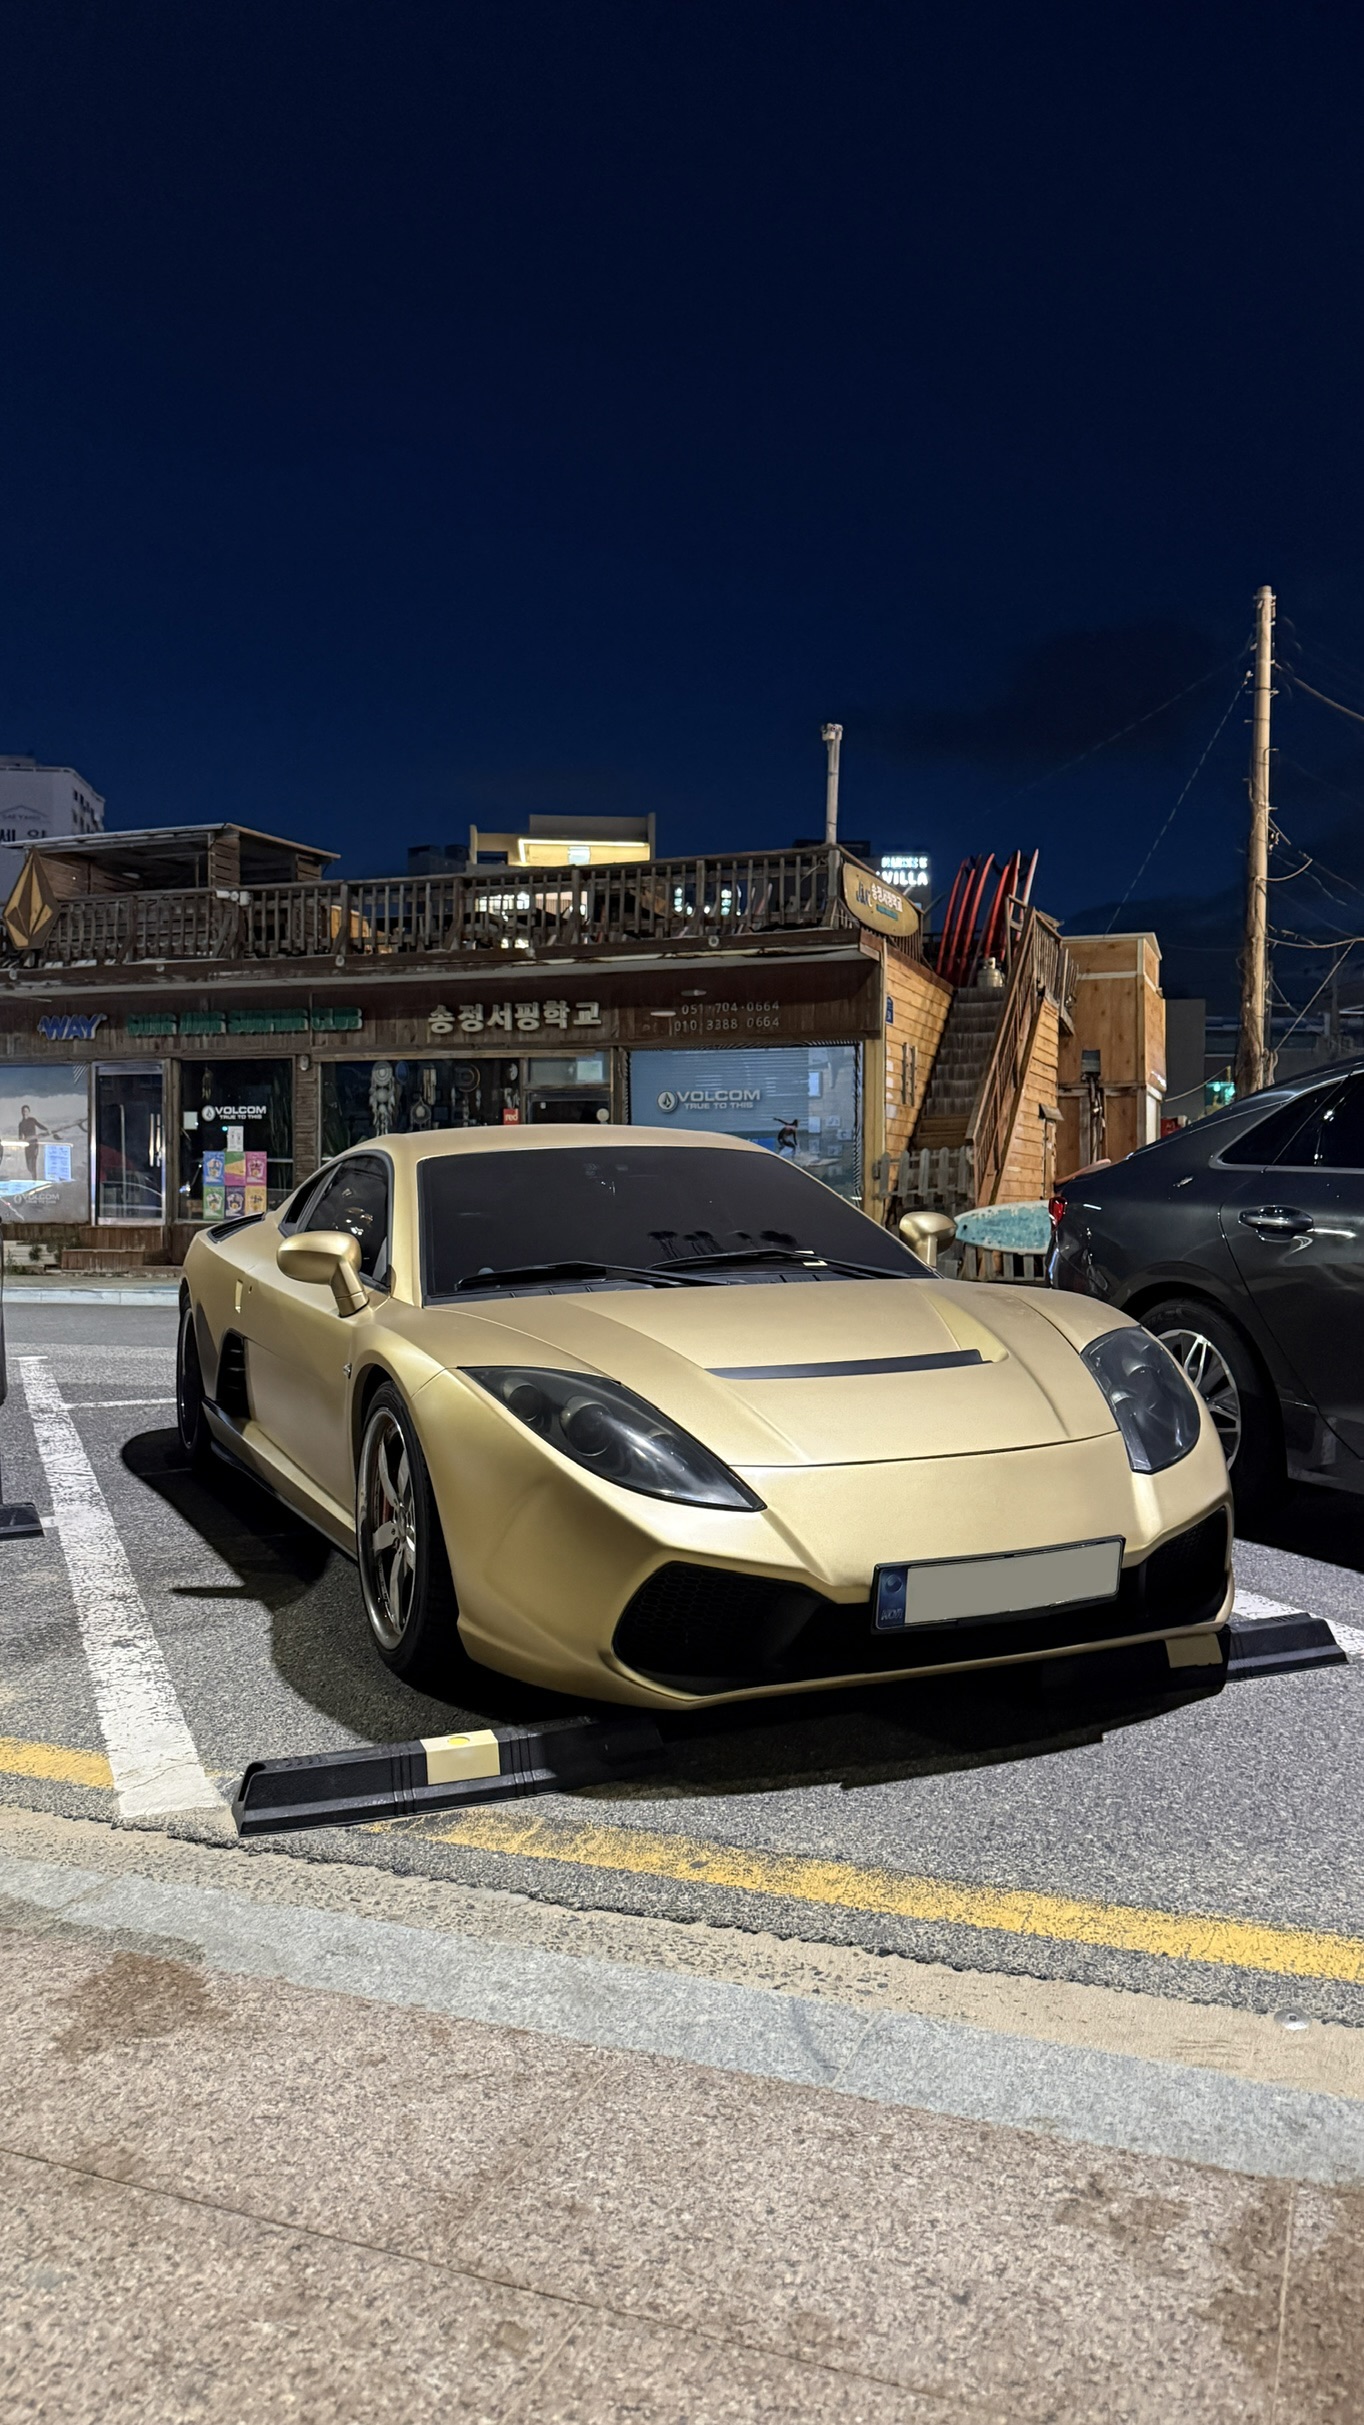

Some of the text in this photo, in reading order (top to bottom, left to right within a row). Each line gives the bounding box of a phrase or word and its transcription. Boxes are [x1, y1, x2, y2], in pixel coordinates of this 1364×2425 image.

[881, 871, 928, 886] VILLA
[427, 1000, 602, 1034] 송정서핑학교
[37, 1013, 104, 1041] WAY
[677, 1090, 760, 1102] VOLCOM
[215, 1106, 266, 1114] VOLCOM
[505, 1108, 519, 1121] red
